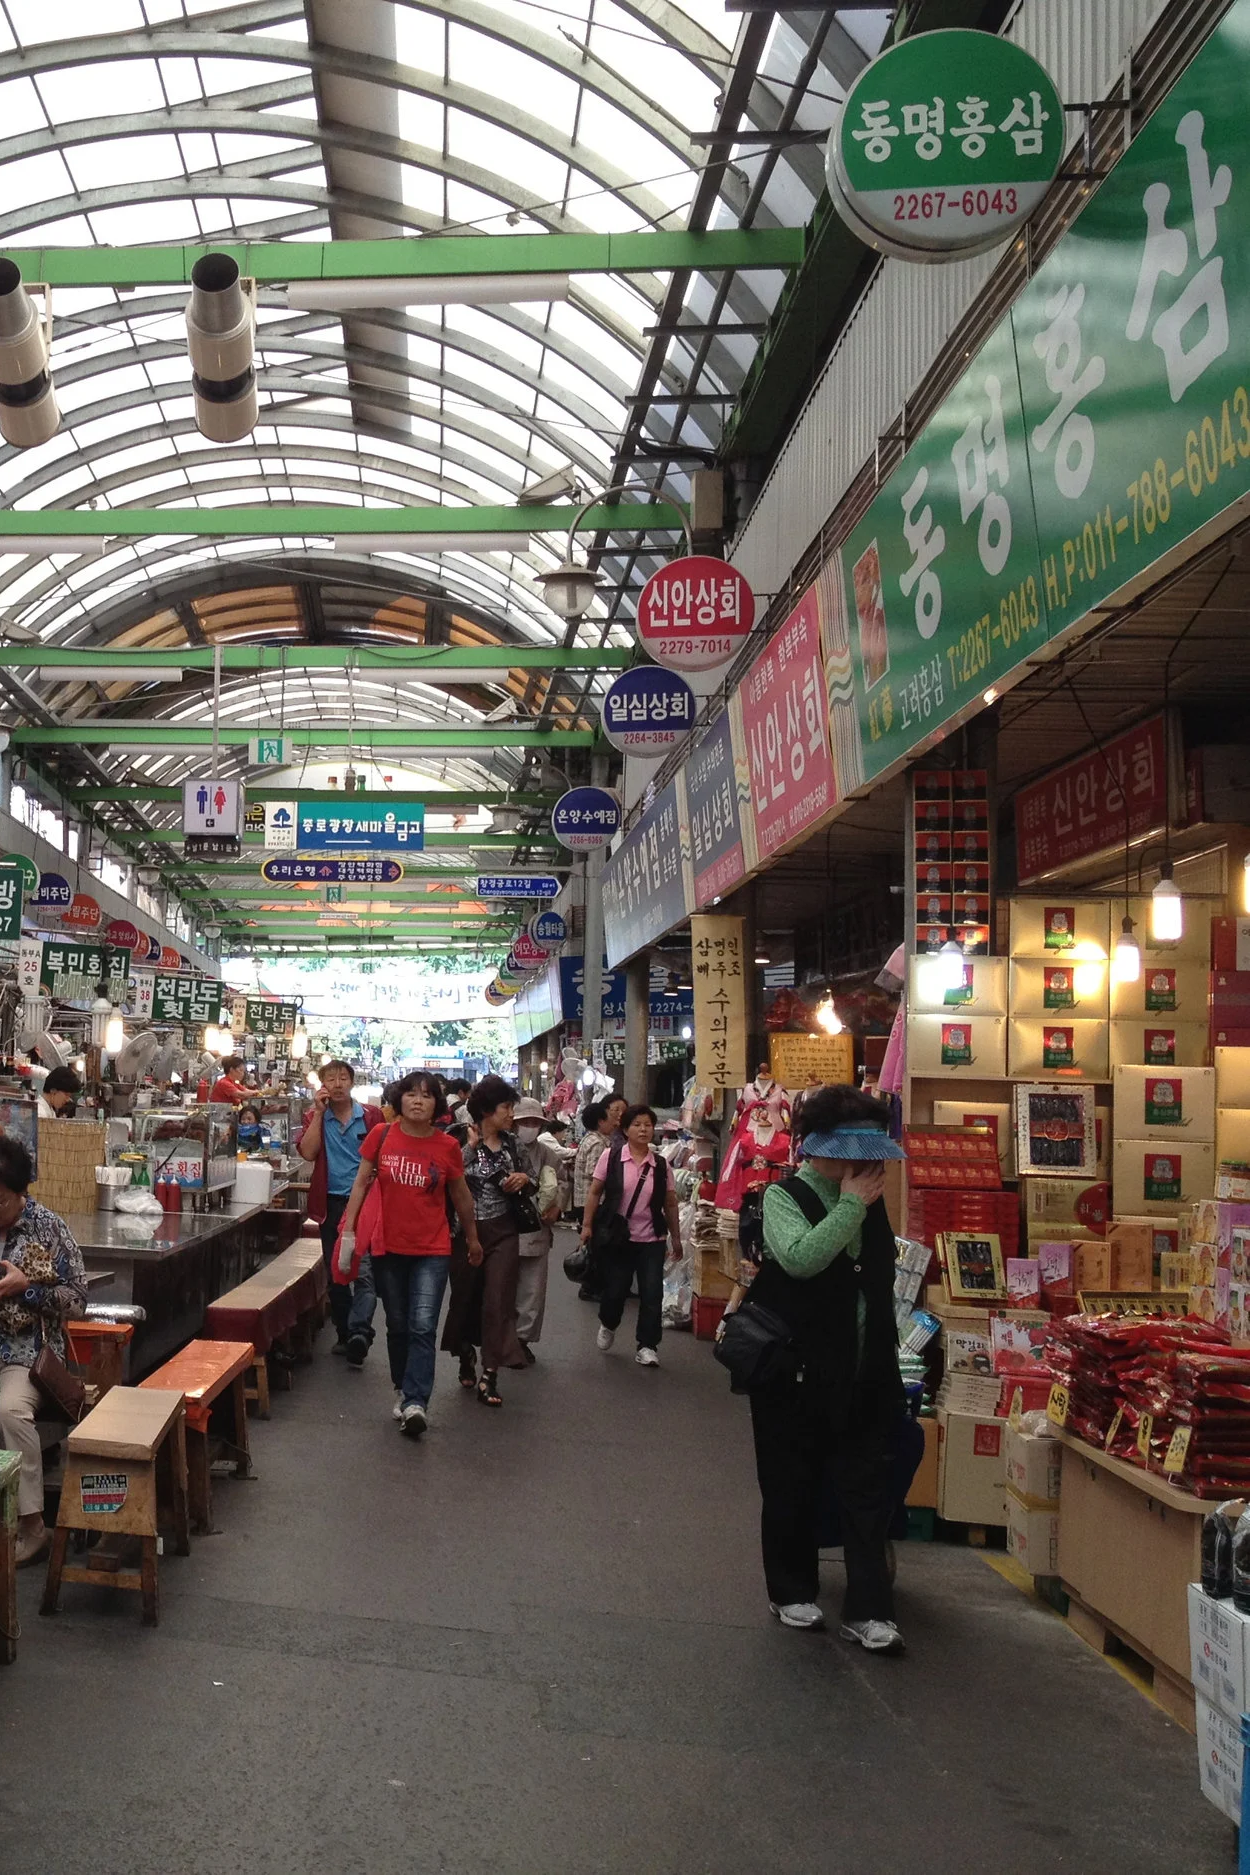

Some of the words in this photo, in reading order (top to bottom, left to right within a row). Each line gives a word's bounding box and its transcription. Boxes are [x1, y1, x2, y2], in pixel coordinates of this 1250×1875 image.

[851, 90, 1050, 163] 동명홍삼
[893, 188, 1019, 221] 2267-6043
[899, 110, 1232, 639] 동명홍삼
[648, 576, 740, 628] 신안상회
[659, 639, 731, 655] 2279-7014
[899, 653, 945, 730] 고려홍삼
[608, 692, 689, 722] 일심상회
[623, 732, 676, 745] 2264-3845
[750, 655, 828, 815] 신안상회
[1052, 735, 1156, 837] 신안상회
[556, 809, 617, 824] 온양수예점
[692, 776, 735, 861] 일심상회
[269, 865, 316, 877] 우리은행
[24, 961, 38, 972] 25
[23, 975, 34, 986] 호
[156, 978, 220, 1003] 전라도
[162, 1002, 211, 1022] 횟집
[250, 1004, 294, 1021] 전라도
[255, 1021, 285, 1034] 횟집
[706, 988, 731, 1085] 수의전문
[400, 1156, 422, 1173] FEEL
[390, 1167, 429, 1188] NATURE
